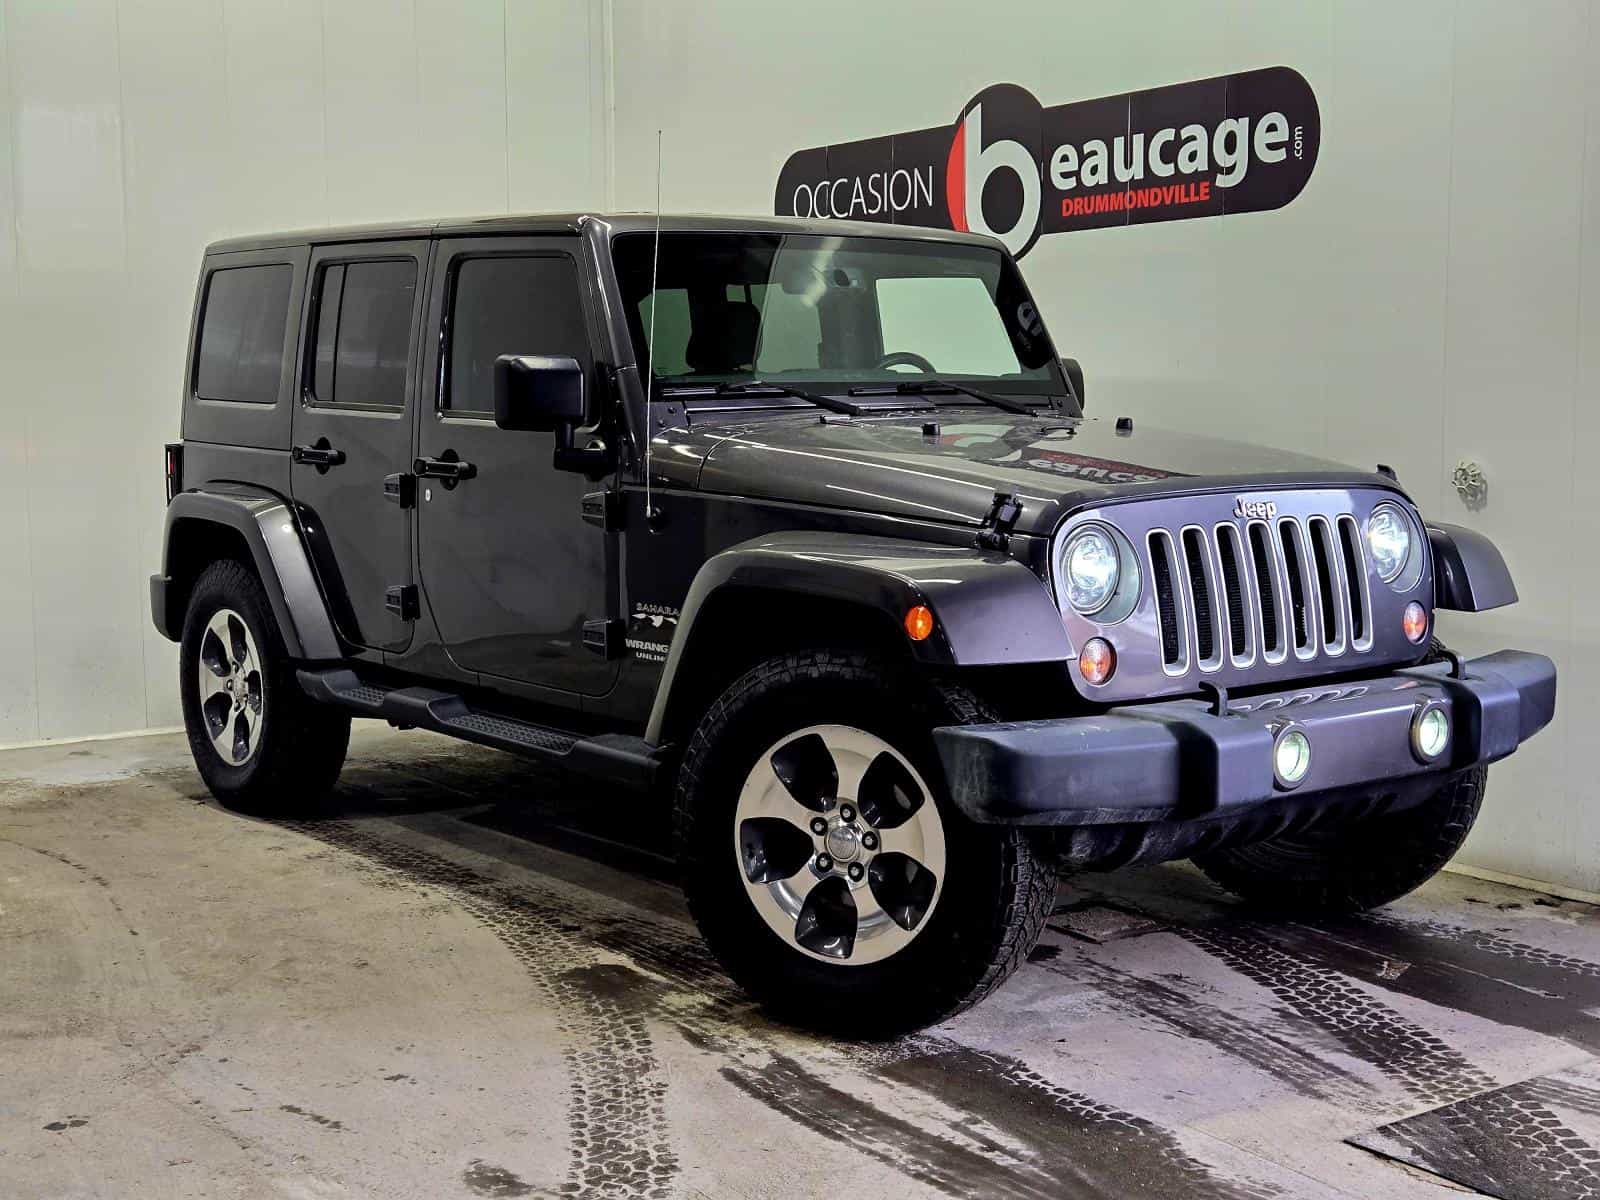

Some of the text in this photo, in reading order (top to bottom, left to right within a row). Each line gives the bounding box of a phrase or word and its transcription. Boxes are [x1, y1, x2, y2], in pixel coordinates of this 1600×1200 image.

[794, 165, 934, 219] OCCASION
[1294, 126, 1303, 160] .com
[1062, 181, 1211, 217] DRUMMONDVILLE
[1232, 495, 1277, 520] Jeep
[636, 602, 680, 616] SAHARA
[625, 638, 669, 653] WRANG
[636, 651, 665, 662] UNLIM
